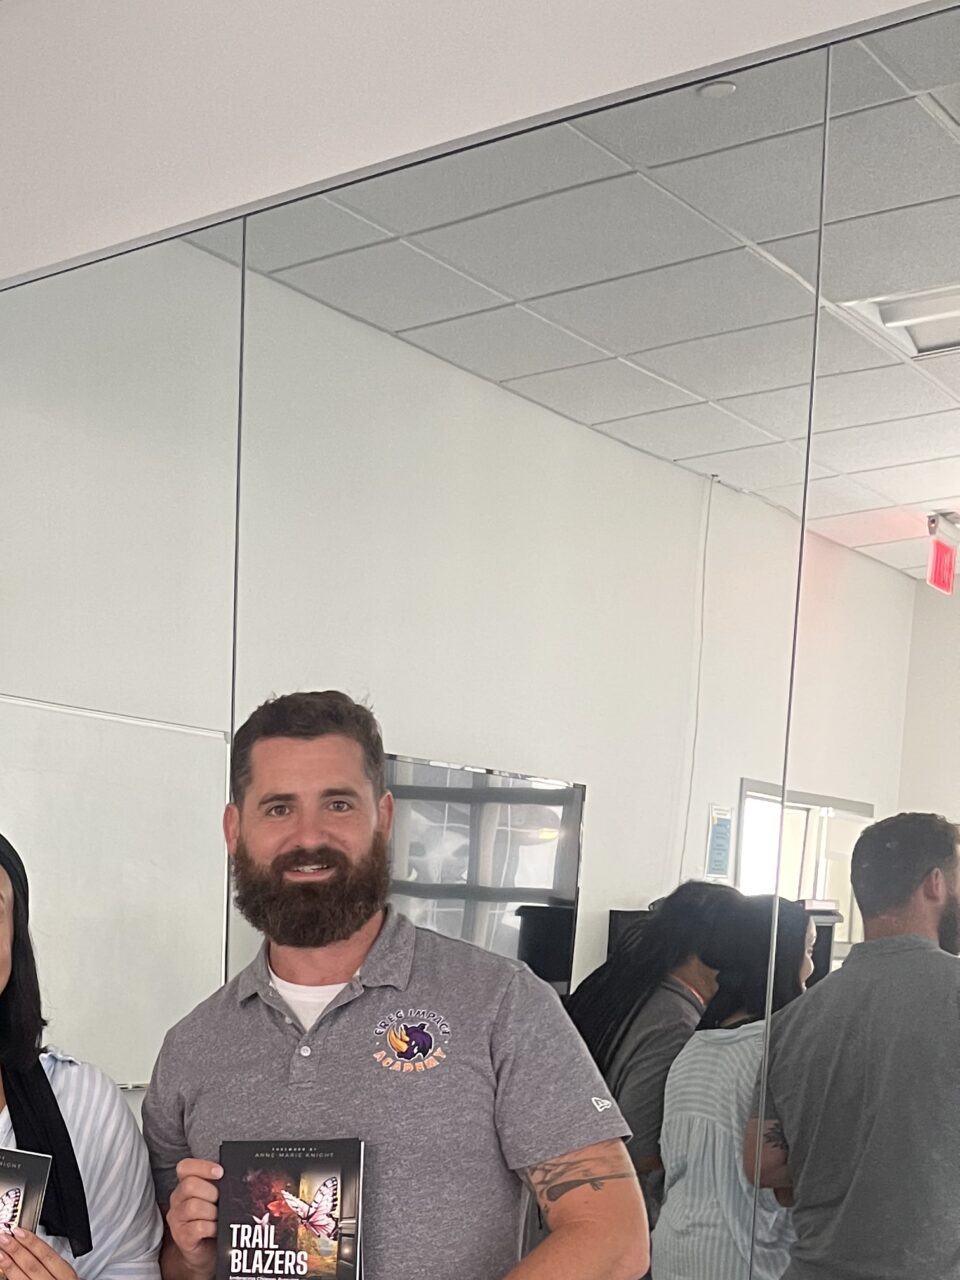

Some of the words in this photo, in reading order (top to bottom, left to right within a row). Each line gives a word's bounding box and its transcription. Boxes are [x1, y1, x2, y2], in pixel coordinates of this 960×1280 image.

[408, 1008, 451, 1036] IMPACT
[373, 1047, 447, 1073] ACADEMY
[230, 1224, 279, 1249] TRAIL
[230, 1249, 308, 1276] BLAZERS
